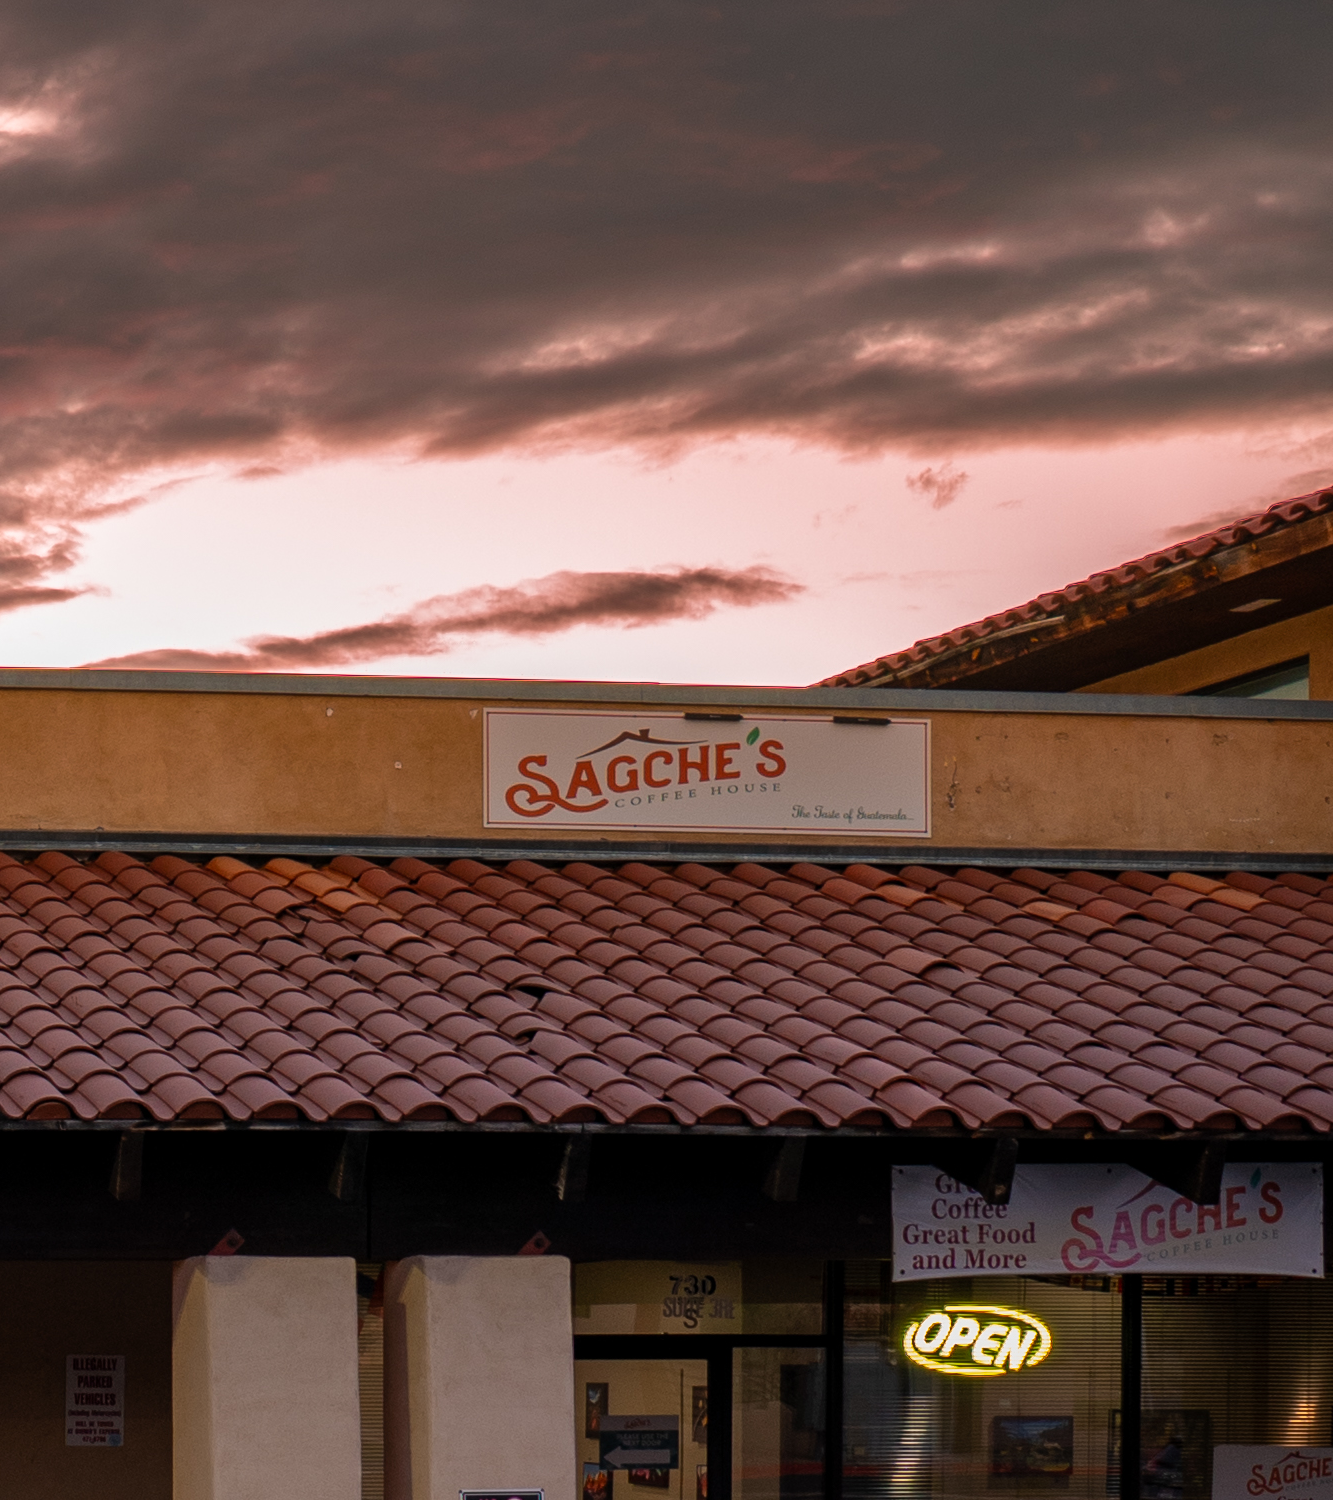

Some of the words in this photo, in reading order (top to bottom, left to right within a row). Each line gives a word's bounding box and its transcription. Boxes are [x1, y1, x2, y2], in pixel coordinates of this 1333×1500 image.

[615, 789, 696, 808] COFFEE
[711, 783, 781, 795] HOUSE
[791, 804, 811, 819] The
[814, 804, 840, 819] Taste
[843, 808, 853, 824] of
[932, 1198, 1007, 1220] Coffee
[903, 1223, 969, 1244] Great
[977, 1222, 1036, 1244] Food
[1146, 1238, 1213, 1262] COFFEE
[1222, 1230, 1280, 1246] HOUSE
[912, 1248, 957, 1270] and
[963, 1249, 1027, 1269] More
[669, 1275, 716, 1295] 730
[912, 1311, 1037, 1372] OPEN
[73, 1358, 117, 1371] ILLEGALLY
[77, 1375, 112, 1388] PARKED
[74, 1393, 116, 1406] VEHICLES
